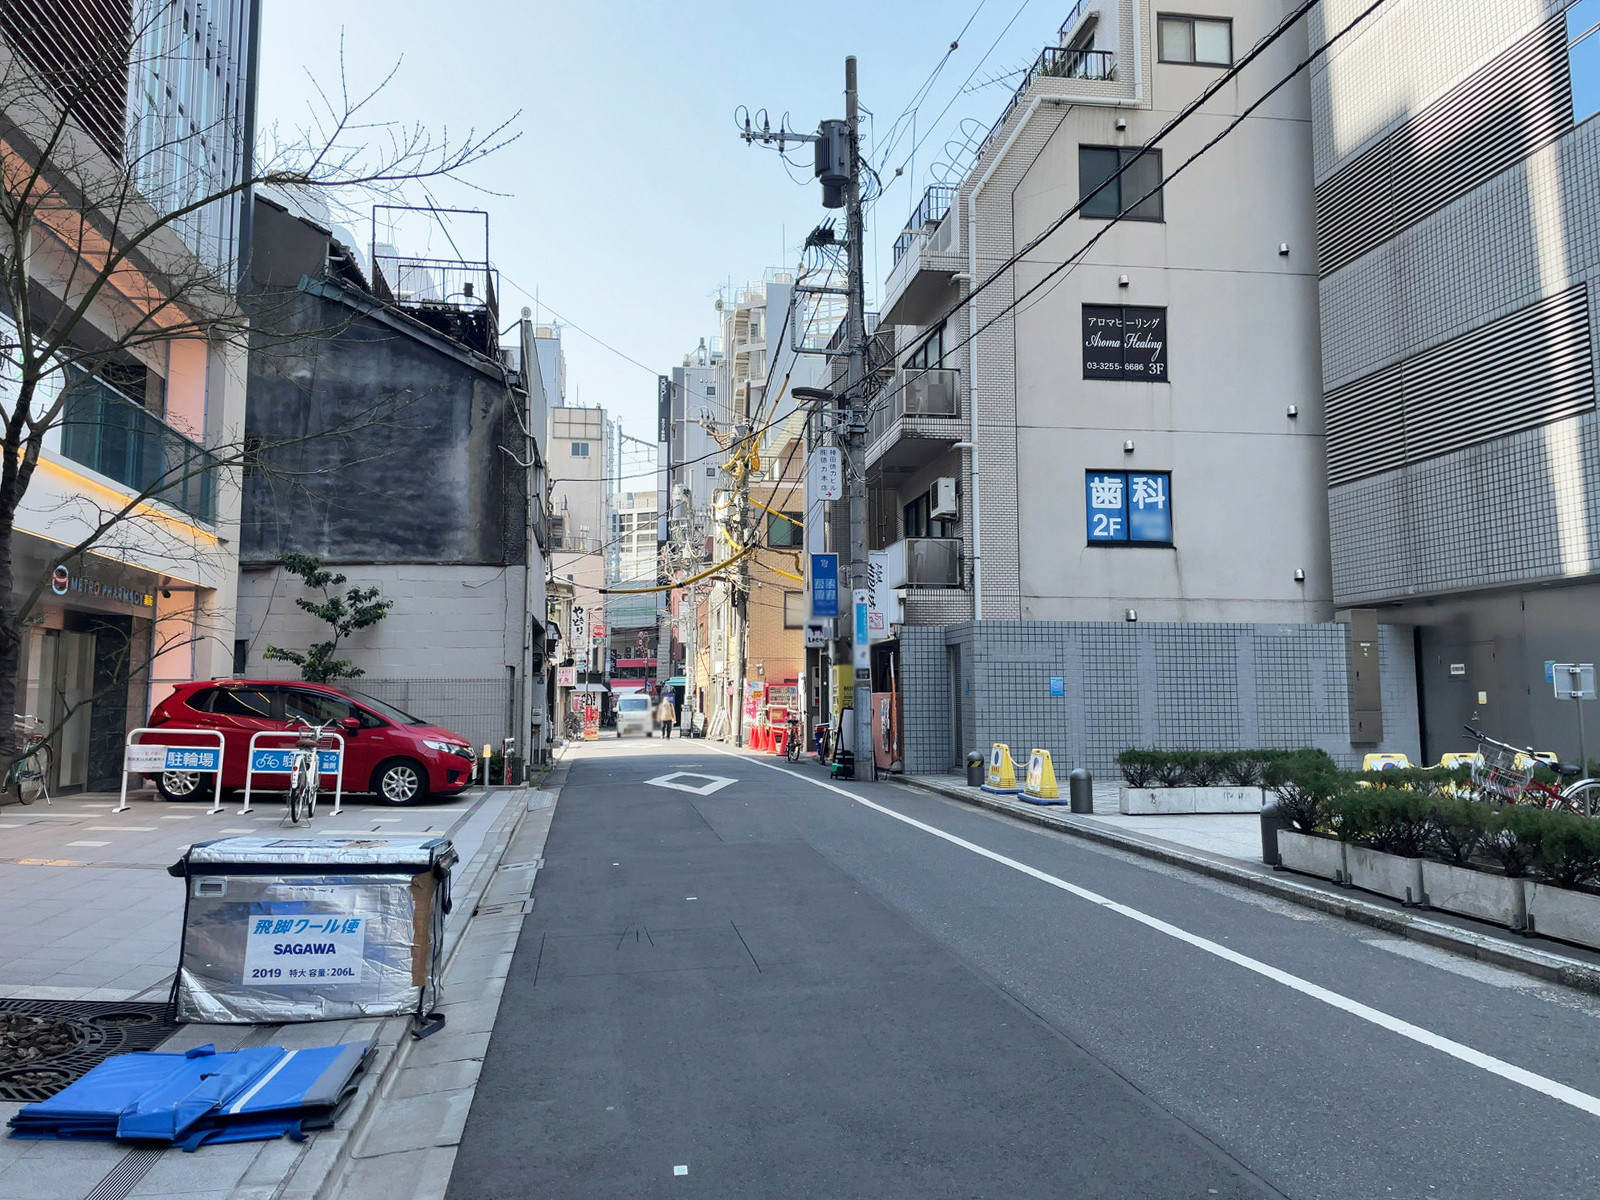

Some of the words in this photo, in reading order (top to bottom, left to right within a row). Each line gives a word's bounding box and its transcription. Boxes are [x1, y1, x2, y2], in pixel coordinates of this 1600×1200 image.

[1088, 317, 1160, 329] アロマヒーリング
[1085, 331, 1121, 348] Aroma
[1124, 332, 1163, 362] Healing
[1148, 363, 1164, 375] 3F
[1090, 476, 1165, 509] 歯科
[1093, 513, 1122, 536] 2F
[70, 576, 100, 595] METRO
[102, 585, 144, 606] PHARMACY
[572, 605, 585, 635] やきとり
[167, 752, 214, 767] 駐輪場
[323, 754, 337, 762] この
[253, 918, 362, 935] 飛脚クール便
[273, 943, 336, 955] SAGAWA
[252, 968, 281, 978] 2019
[289, 968, 307, 978] 特大
